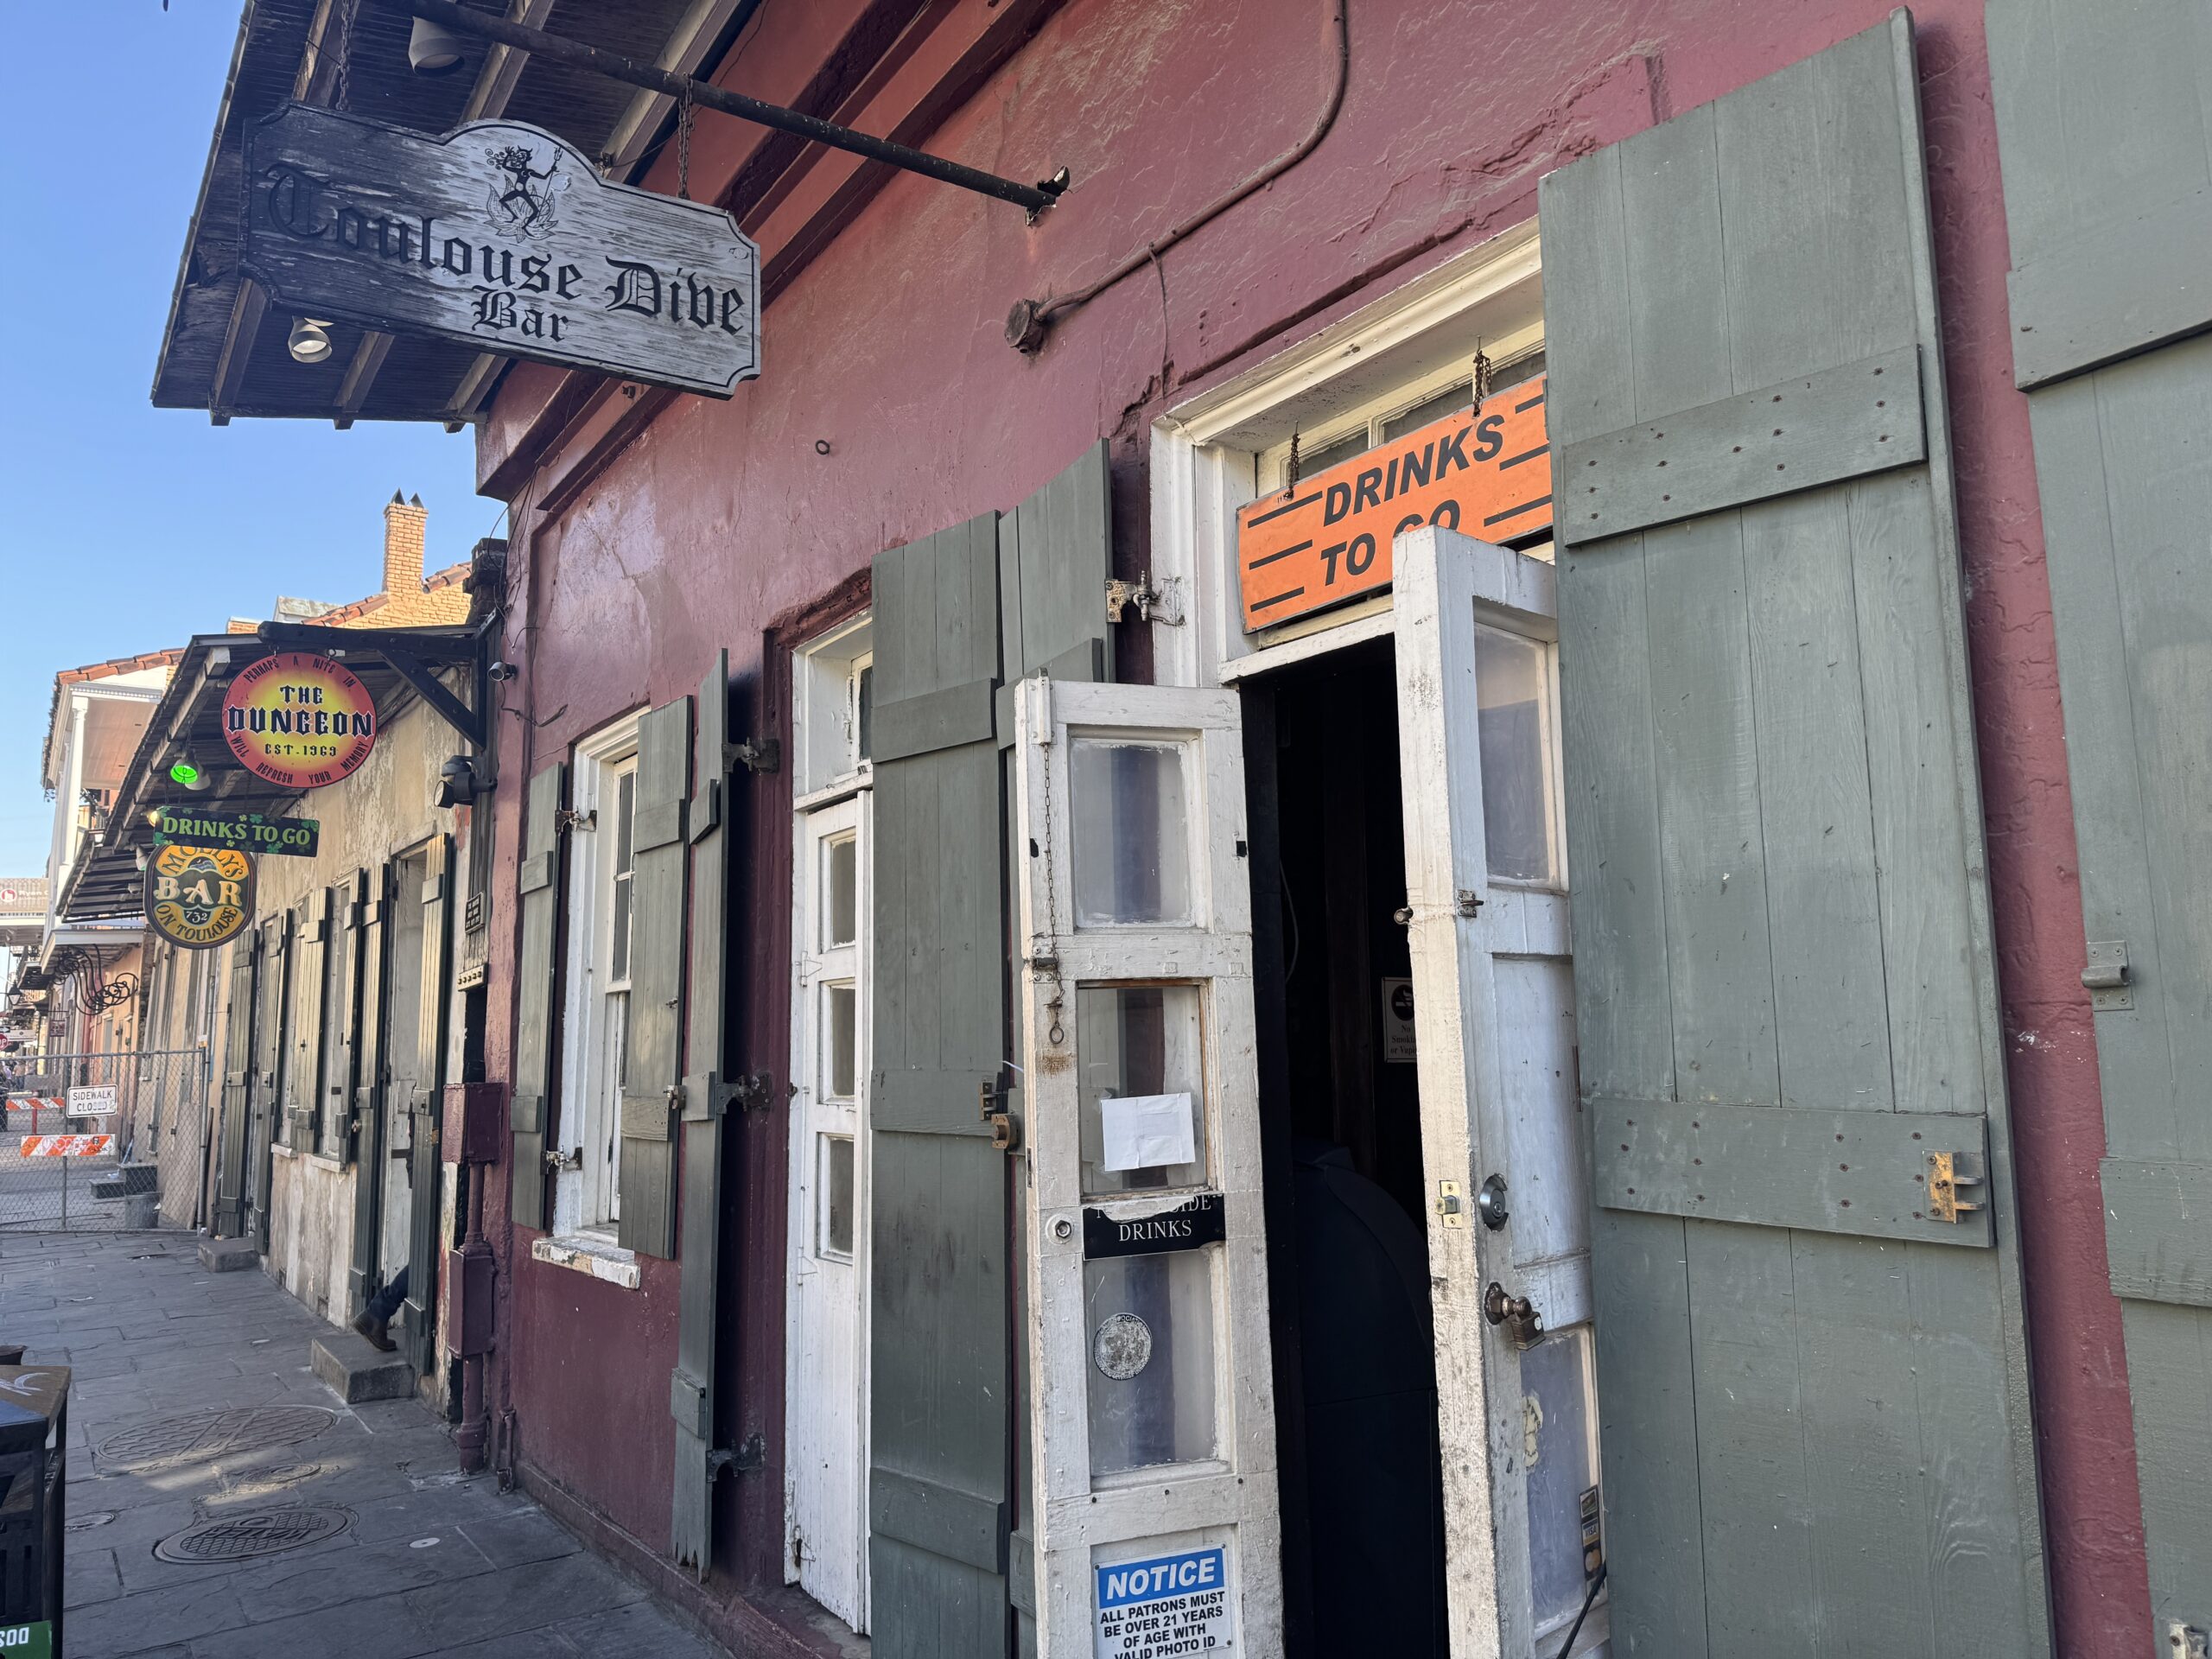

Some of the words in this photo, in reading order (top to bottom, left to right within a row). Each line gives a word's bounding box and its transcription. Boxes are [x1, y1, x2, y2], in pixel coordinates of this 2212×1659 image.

[266, 163, 583, 300] Toulouse
[606, 257, 745, 335] Dive
[471, 285, 569, 342] Bar
[1323, 415, 1505, 526] DRINKS
[1320, 532, 1376, 586] TO
[243, 658, 279, 683] PERHAPS
[293, 656, 298, 665] A
[313, 658, 336, 674] NITE
[343, 677, 355, 688] IN
[280, 685, 322, 704] THE
[227, 705, 373, 739] DUNGEON
[231, 736, 249, 758] WILL
[256, 761, 293, 784] REFRESH
[308, 771, 332, 784] YOUR
[340, 741, 369, 772] MEMORY
[162, 817, 247, 840] DRINKS
[251, 825, 278, 842] TO
[283, 829, 310, 845] GO
[154, 877, 242, 906] BAR
[157, 905, 175, 926] ON
[177, 907, 238, 941] TOULOUSE
[186, 912, 207, 923] 732
[73, 1090, 112, 1101] SIDEWALK
[1118, 1220, 1192, 1242] DRINKS
[198, 1529, 311, 1540] WATER
[1107, 1557, 1216, 1599] NOTICE
[1100, 1610, 1124, 1624] ALL
[1128, 1599, 1186, 1619] PATRONS
[1191, 1591, 1225, 1608] MUST
[1104, 1624, 1121, 1637] BE
[1125, 1617, 1160, 1634] OVER
[1163, 1614, 1177, 1627] 21
[1182, 1605, 1223, 1624] YEARS
[1123, 1637, 1140, 1649] OF
[1144, 1630, 1170, 1645] AGE
[1173, 1624, 1206, 1639] WITH
[1157, 1638, 1199, 1657] PHOTO
[1204, 1636, 1216, 1648] ID
